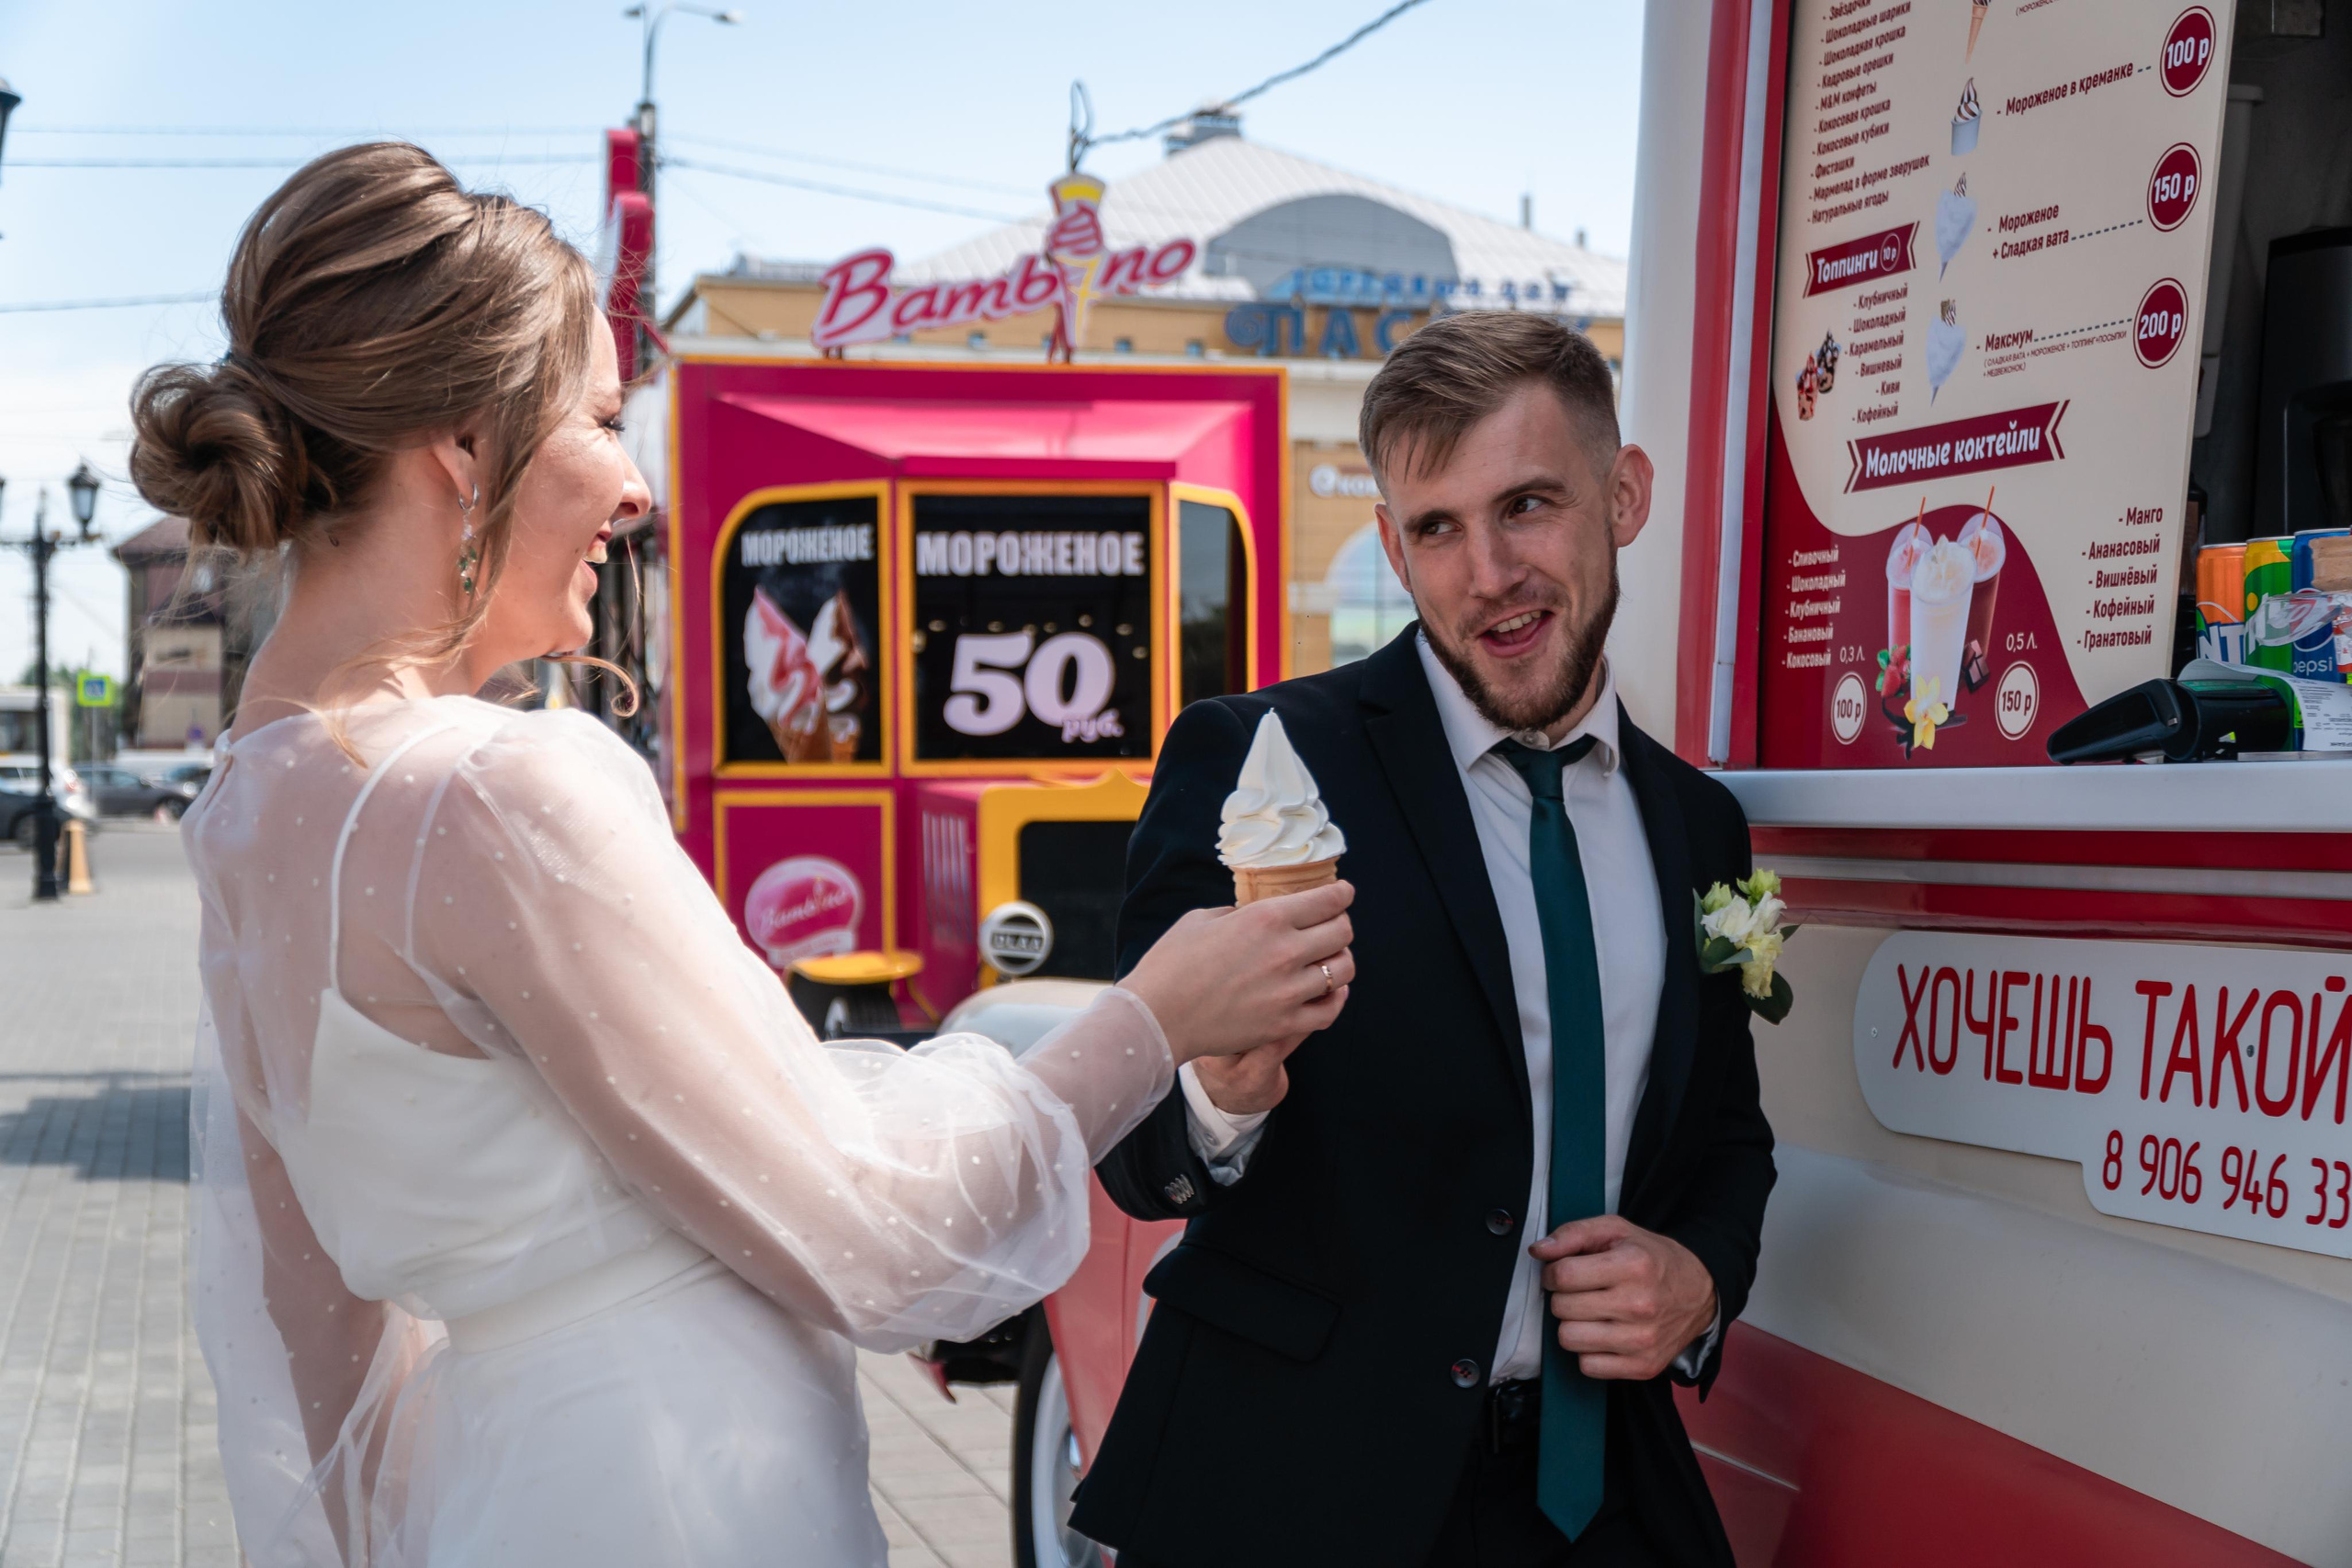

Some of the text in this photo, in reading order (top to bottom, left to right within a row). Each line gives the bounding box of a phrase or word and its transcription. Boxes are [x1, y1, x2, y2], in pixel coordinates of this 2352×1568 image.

[1826, 1, 1911, 43] Шоколадные шарики
[1824, 26, 1905, 66] Шоколадная крошка
[2166, 37, 2210, 69] 100 р
[1822, 53, 1894, 88] Кедровые орешки
[1842, 82, 1876, 102] конфеты
[2006, 62, 2133, 116] Мороженое в креманке
[1818, 99, 1890, 133] Кокосовая крошка
[1817, 122, 1889, 156] Кокосовые кубики
[1814, 179, 1853, 201] Мармелад
[1861, 168, 1887, 189] форме
[1889, 154, 1929, 177] зверушек
[1815, 156, 1854, 179] Фисташки
[2154, 173, 2195, 204] 150 р
[1812, 190, 1888, 224] Натуральные ягоды
[1998, 204, 2060, 233] Мороженое
[2001, 236, 2043, 259] Сладкая
[2046, 230, 2069, 249] вата
[1817, 249, 1879, 284] Топпинги
[1859, 282, 1907, 310] Клубничный
[1853, 306, 1905, 333] Шоколадный
[2139, 310, 2181, 340] 200 р
[1849, 330, 1904, 357] Карамельный
[1985, 329, 2033, 353] Максмум
[1881, 380, 1900, 396] Киви
[1857, 400, 1898, 425] Кофейный
[1865, 420, 2041, 478] Молочные коктейли
[2126, 507, 2163, 526] Манго
[741, 524, 873, 568] МОРОЖЕНОЕ
[916, 531, 1145, 577] МОРОЖЕНОЕ
[1792, 545, 1839, 568] Сливочный
[2088, 533, 2160, 560] Ананасовый
[1792, 570, 1846, 592] Шоколадный
[2096, 564, 2157, 589] Вишнёвый
[1790, 595, 1840, 621] Клубничный
[2093, 595, 2154, 621] Кофейный
[1789, 622, 1834, 644] Банановый
[2007, 633, 2023, 652] 0,5
[2084, 625, 2152, 652] Гранатовый
[1786, 647, 1832, 669] Кокосовый
[944, 631, 1115, 735] 50
[1837, 702, 1853, 718] 100
[2002, 691, 2032, 716] 150 р
[1893, 963, 2352, 1124] ХОЧЕШЬ ТАКОЙ
[2103, 1129, 2351, 1229] 8 906 946 33
